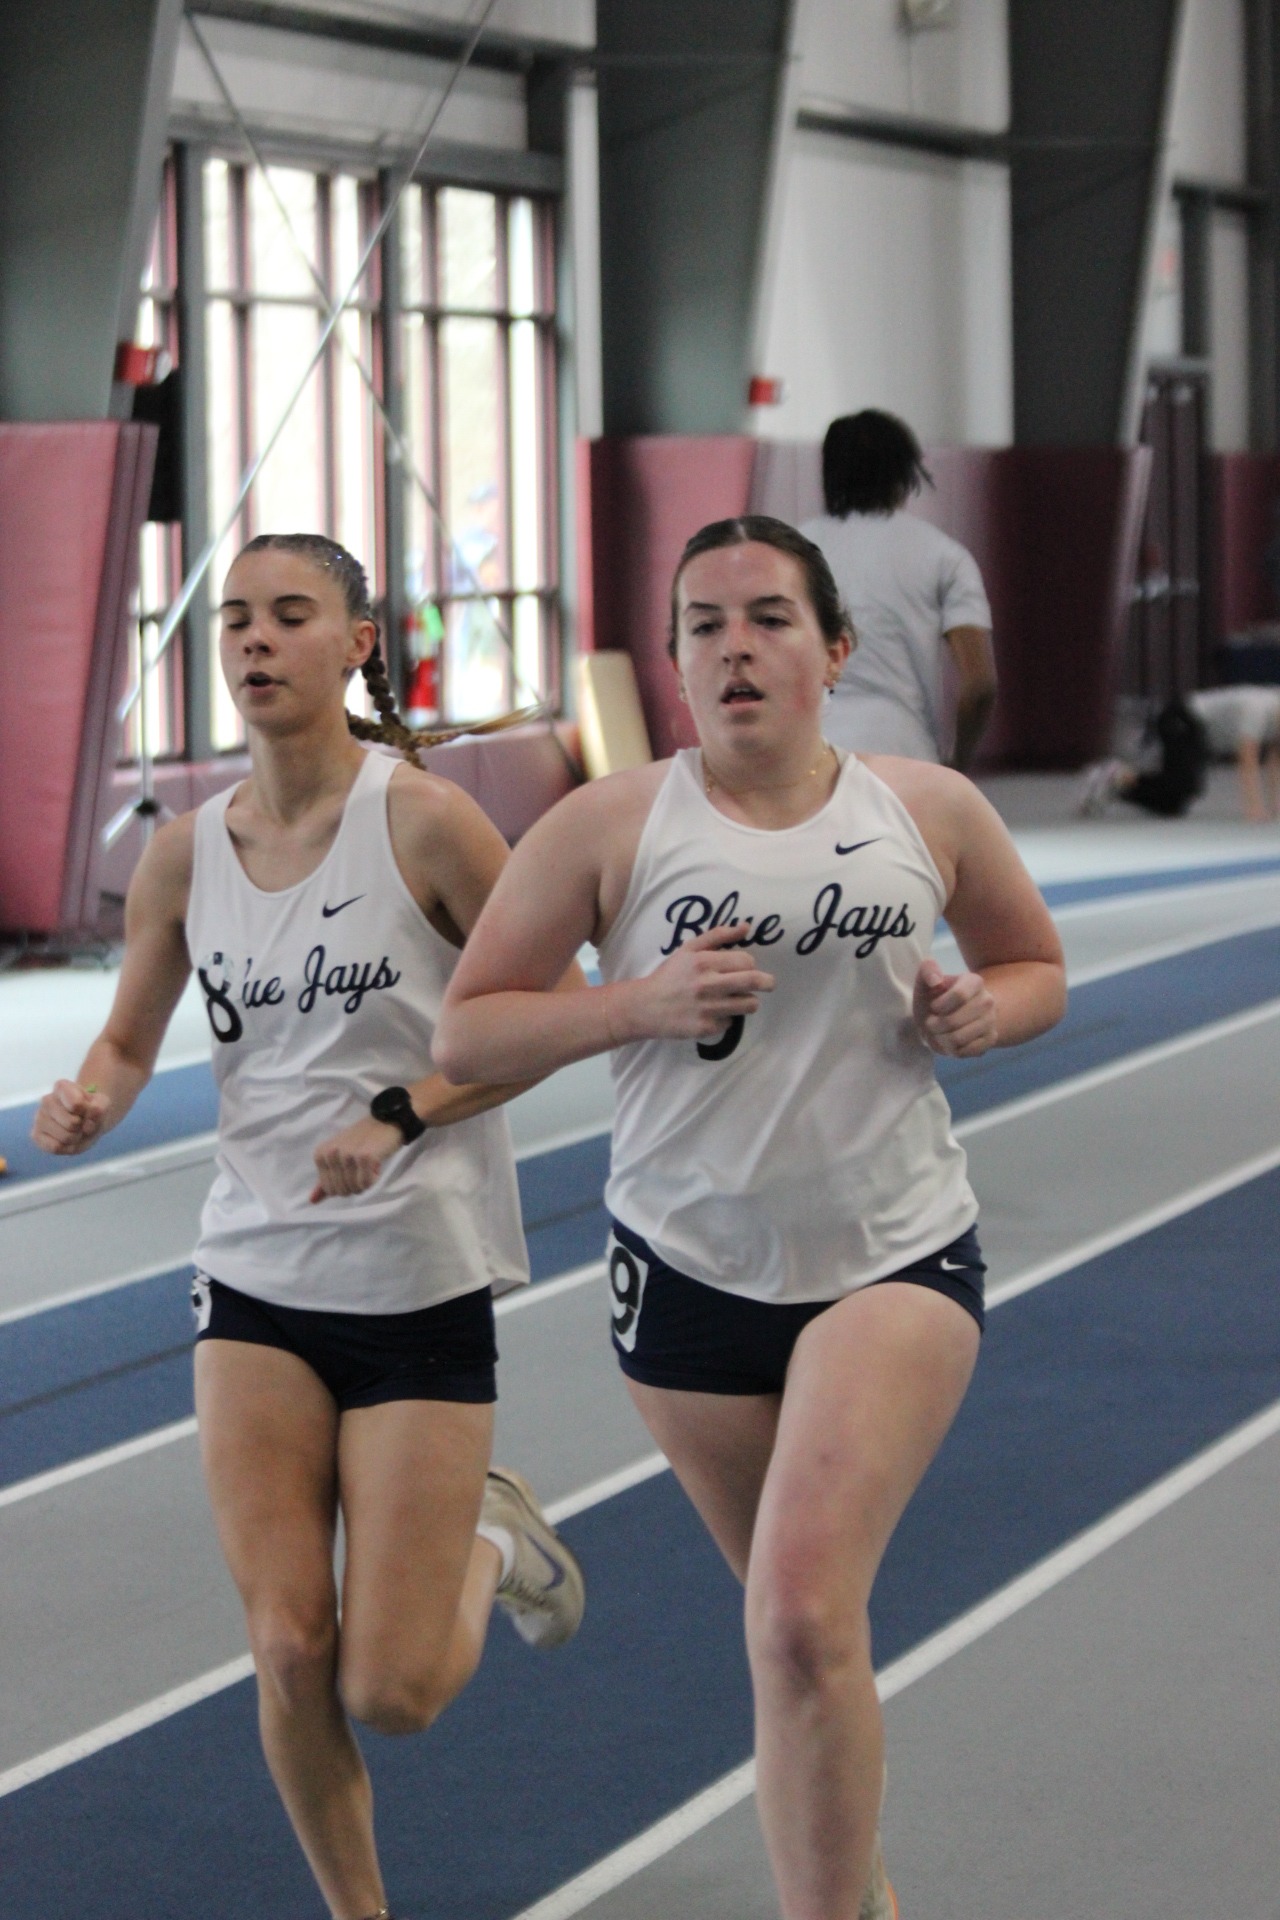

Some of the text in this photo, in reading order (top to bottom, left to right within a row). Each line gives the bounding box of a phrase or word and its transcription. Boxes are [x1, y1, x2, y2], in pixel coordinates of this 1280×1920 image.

[796, 883, 916, 959] Jays
[298, 945, 402, 1014] Jays
[610, 1246, 640, 1335] 9
